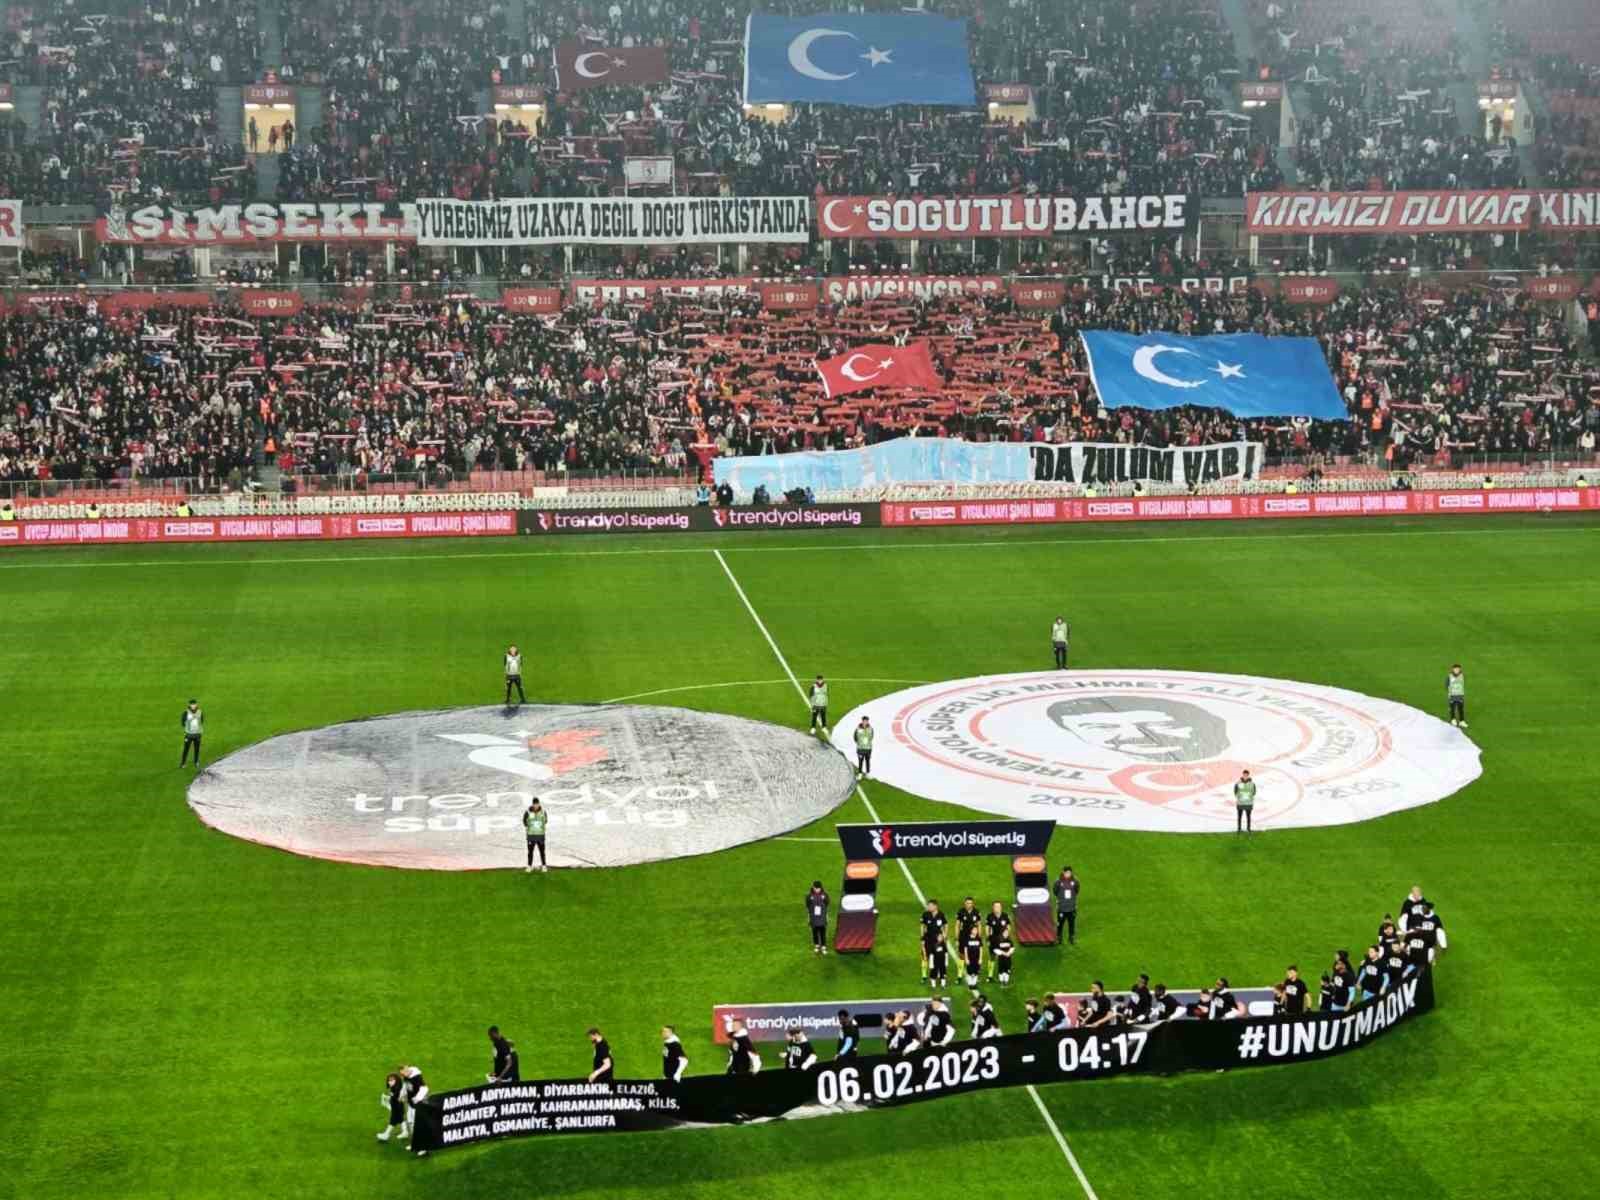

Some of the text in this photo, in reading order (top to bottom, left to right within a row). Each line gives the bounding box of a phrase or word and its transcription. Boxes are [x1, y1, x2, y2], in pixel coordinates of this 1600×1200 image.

[518, 202, 586, 237] UZAKTA
[1252, 195, 1530, 226] KIRMIZI DUVAR
[554, 511, 629, 532] trendyol
[729, 506, 801, 530] trendyol
[345, 780, 719, 814] trendyol
[1028, 793, 1127, 811] 2025
[895, 830, 967, 849] trendyol
[746, 1015, 802, 1031] trendyol
[817, 1045, 1000, 1105] 06.02.2023
[1057, 1031, 1149, 1072] 04:17
[1238, 978, 1418, 1059] #UNUTMADIK
[442, 1092, 479, 1111] ADANA,
[480, 1085, 541, 1103] ADIYAMAN,
[544, 1083, 614, 1097] DİYARBAKIR,
[442, 1105, 499, 1127] GAZİANTEP,
[500, 1101, 538, 1116] HATAY,
[648, 1096, 681, 1110] KİLİS,
[442, 1114, 616, 1143] MALATYA, OSMANİYE, ŞANLIURFA
